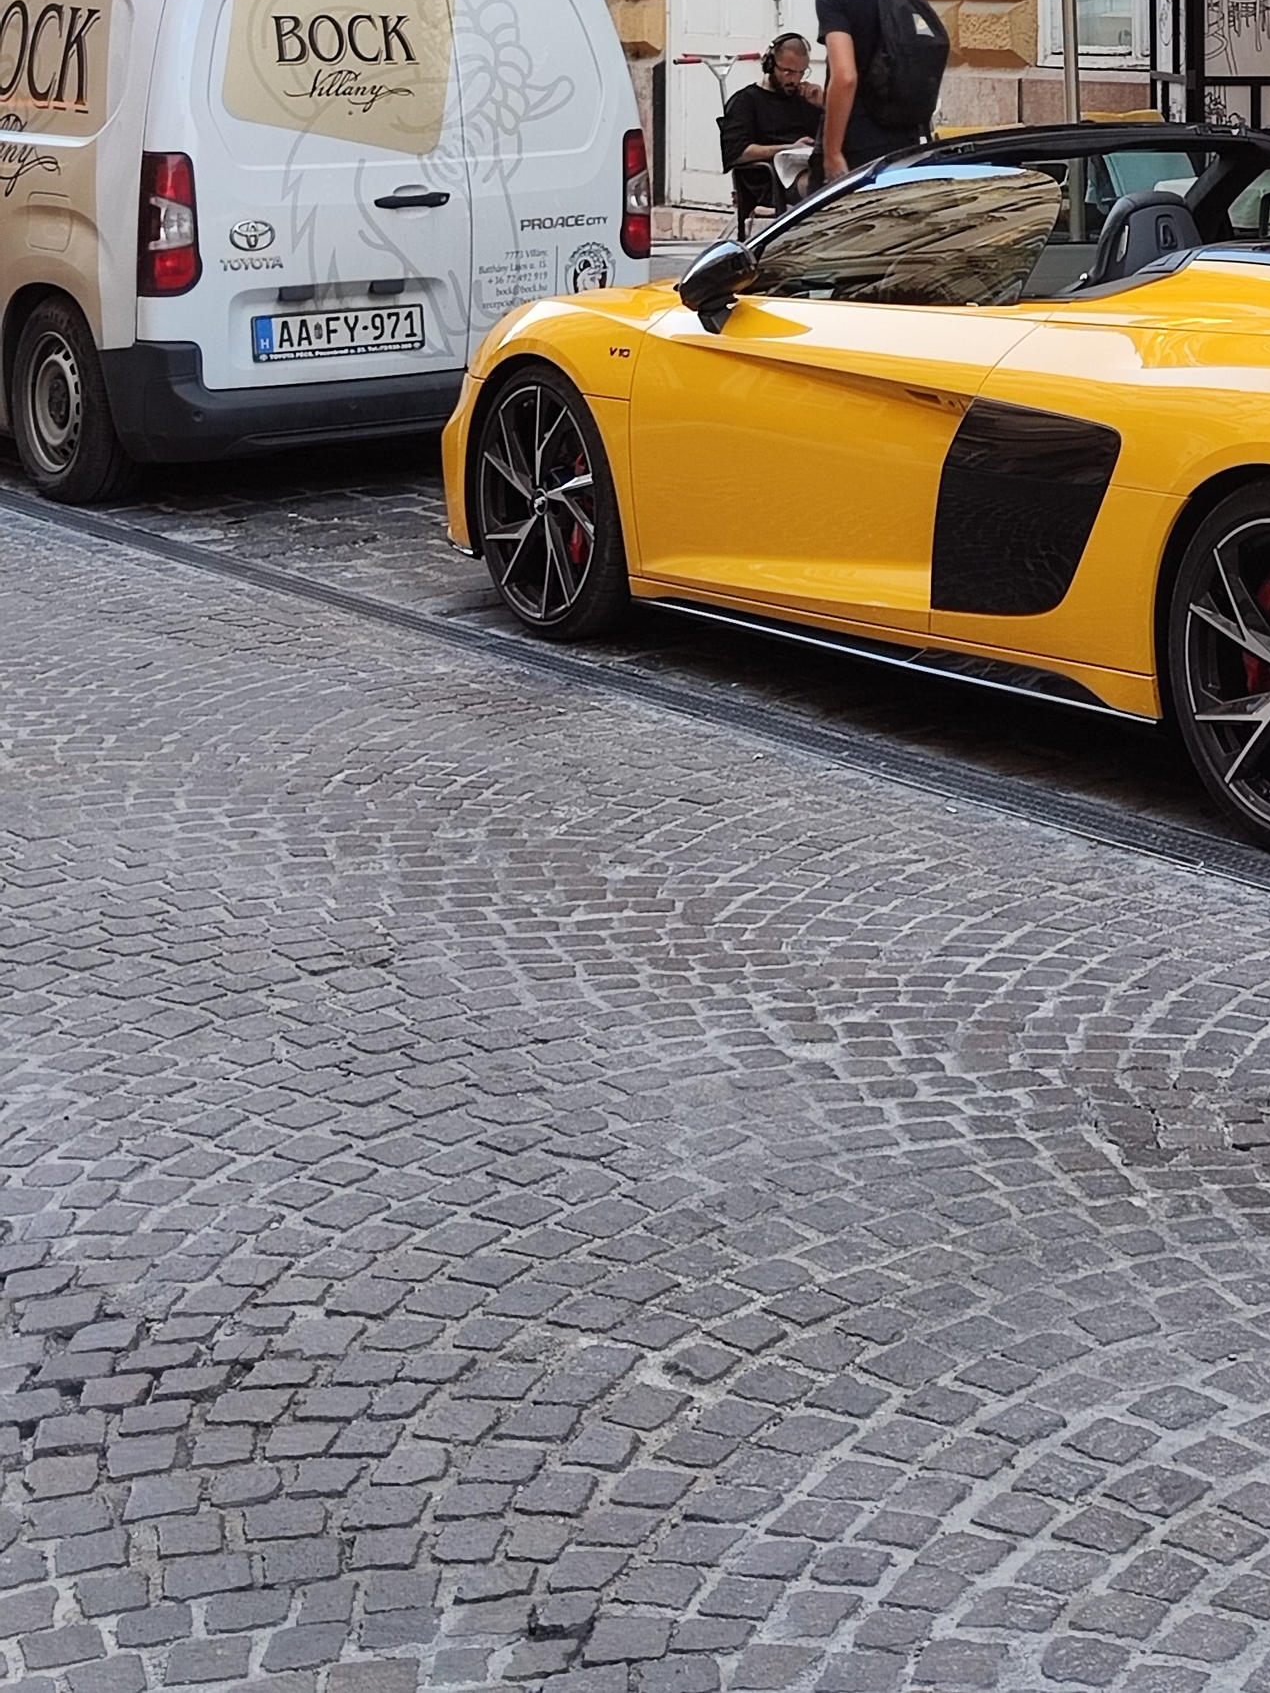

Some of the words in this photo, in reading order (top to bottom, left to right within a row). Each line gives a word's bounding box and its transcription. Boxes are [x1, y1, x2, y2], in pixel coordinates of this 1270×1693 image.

[271, 14, 420, 66] BOCK
[0, 0, 101, 114] OCK
[520, 214, 586, 232] PROACE
[586, 216, 609, 227] CITY
[219, 256, 284, 272] TOYOTA
[260, 338, 270, 350] H
[278, 319, 313, 349] AA
[325, 310, 418, 344] FY-971
[609, 347, 631, 358] V10
